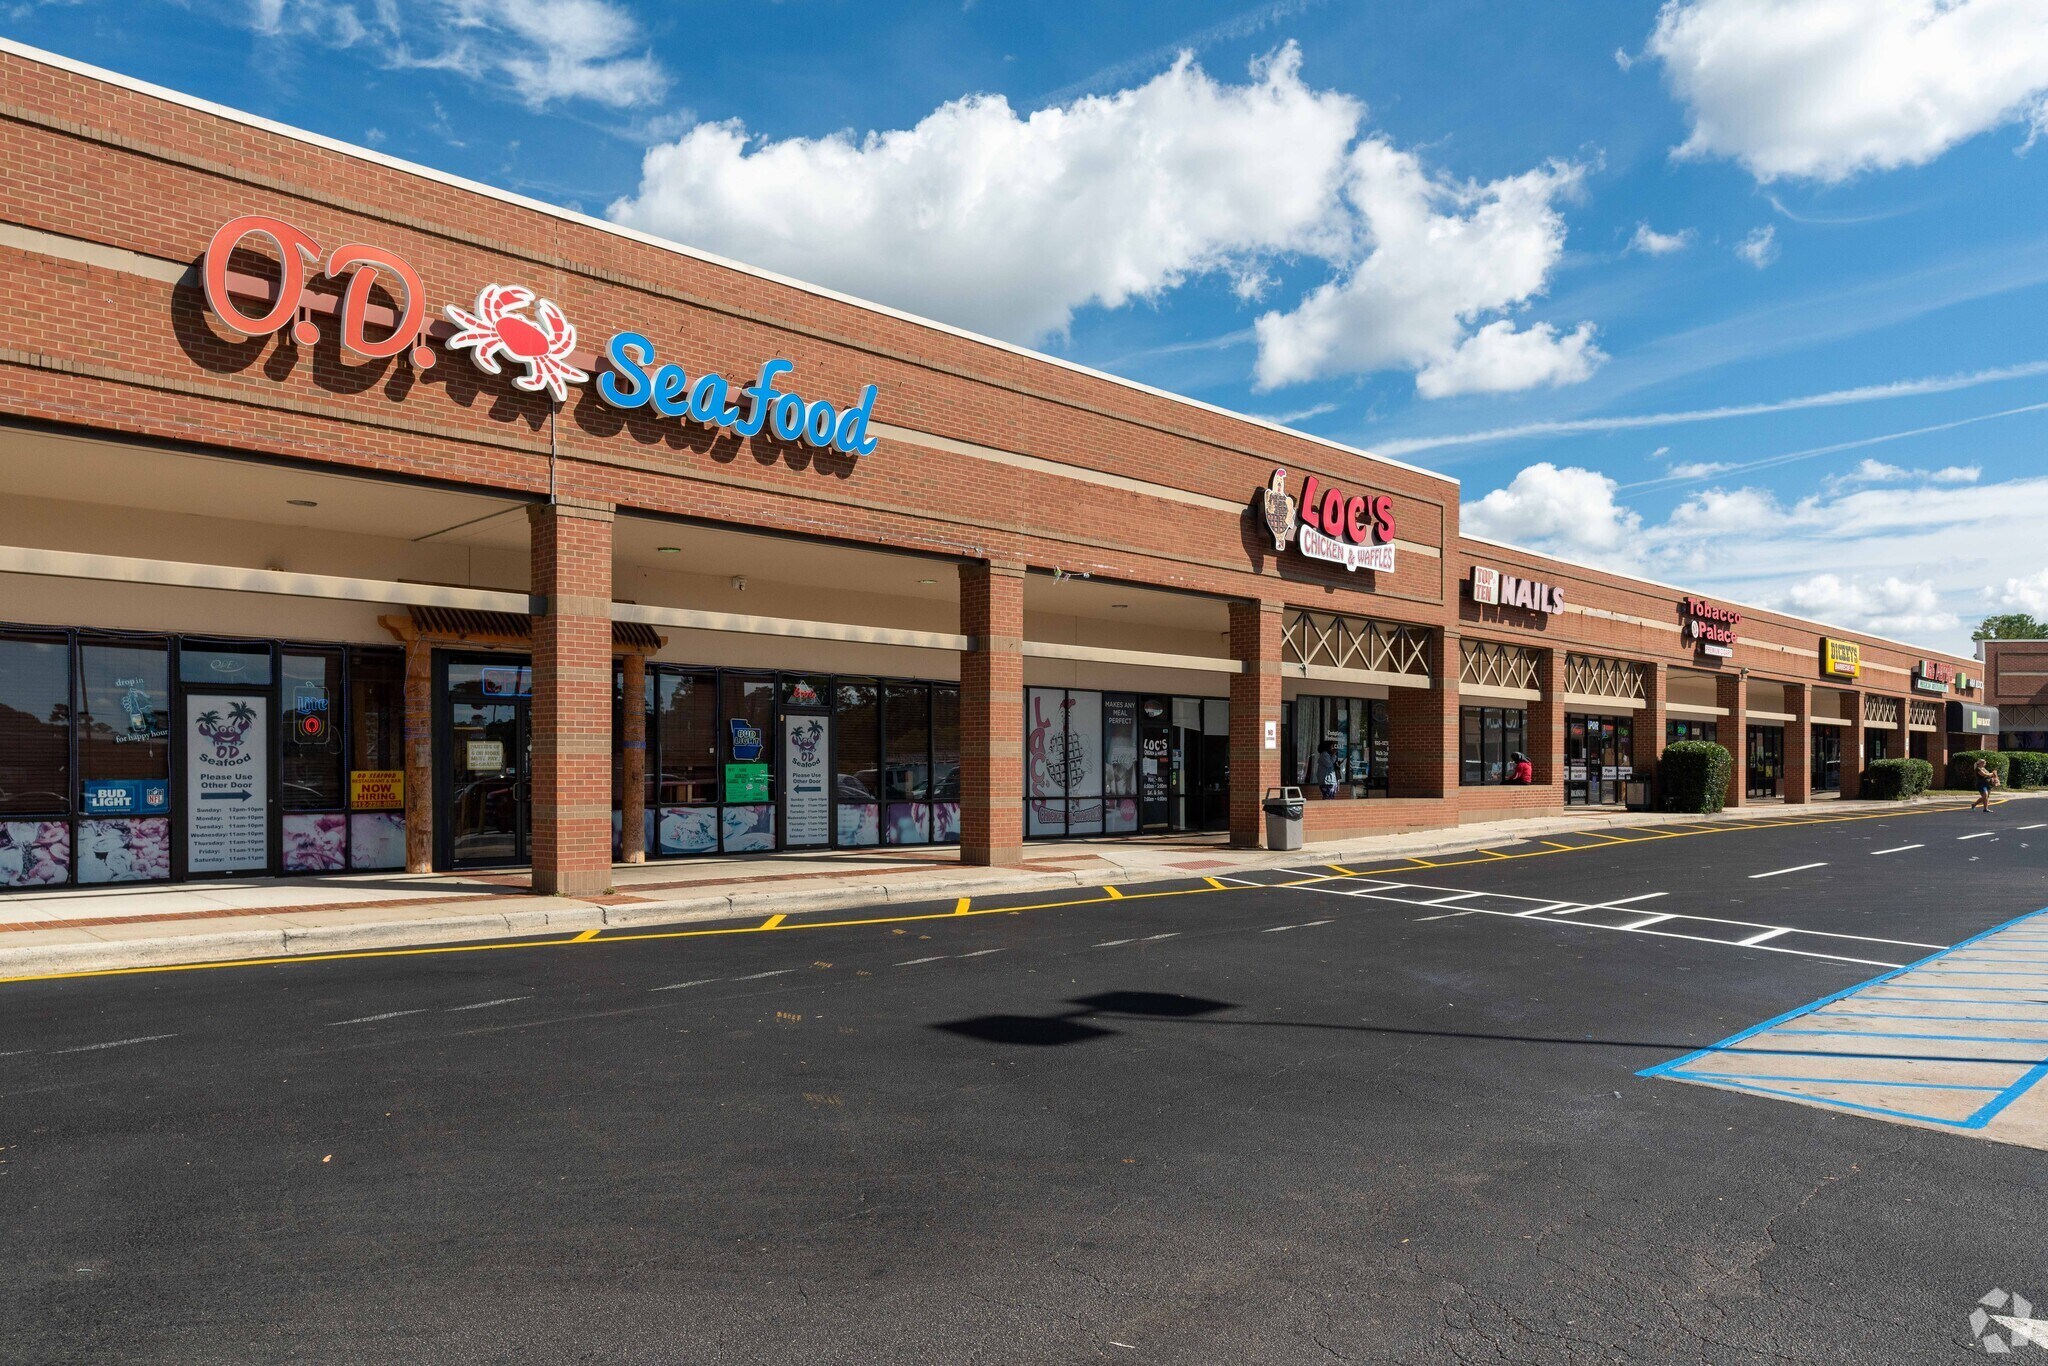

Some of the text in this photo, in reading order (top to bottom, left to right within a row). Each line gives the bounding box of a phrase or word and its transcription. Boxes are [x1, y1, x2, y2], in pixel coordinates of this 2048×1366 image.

[203, 214, 878, 456] O.D. Seafood
[1301, 475, 1396, 544] LOC'S
[1304, 530, 1393, 570] CHICKEN & WAFFLES
[1477, 567, 1494, 585] TOP
[1475, 584, 1492, 602] TEN
[1501, 574, 1564, 615] NAILS
[1687, 597, 1742, 624] Tobacco
[1698, 621, 1738, 644] Palace
[116, 677, 144, 689] drop in
[1105, 702, 1123, 710] MAKES
[1124, 703, 1135, 711] ANY
[1108, 717, 1131, 725] PERFECT
[116, 729, 168, 743] for happy hour
[738, 730, 756, 738] BUD
[1144, 738, 1168, 751] LOC'S
[216, 745, 240, 759] OD
[801, 752, 814, 762] OD
[199, 753, 252, 767] Seafood
[792, 757, 821, 768] Seafood
[200, 773, 253, 781] Please Use
[201, 781, 253, 789] Other Door
[361, 784, 392, 793] NOW
[97, 789, 127, 798] BUD
[148, 795, 162, 804] NFL
[357, 793, 396, 801] HIRING
[92, 797, 132, 807] LIGHT
